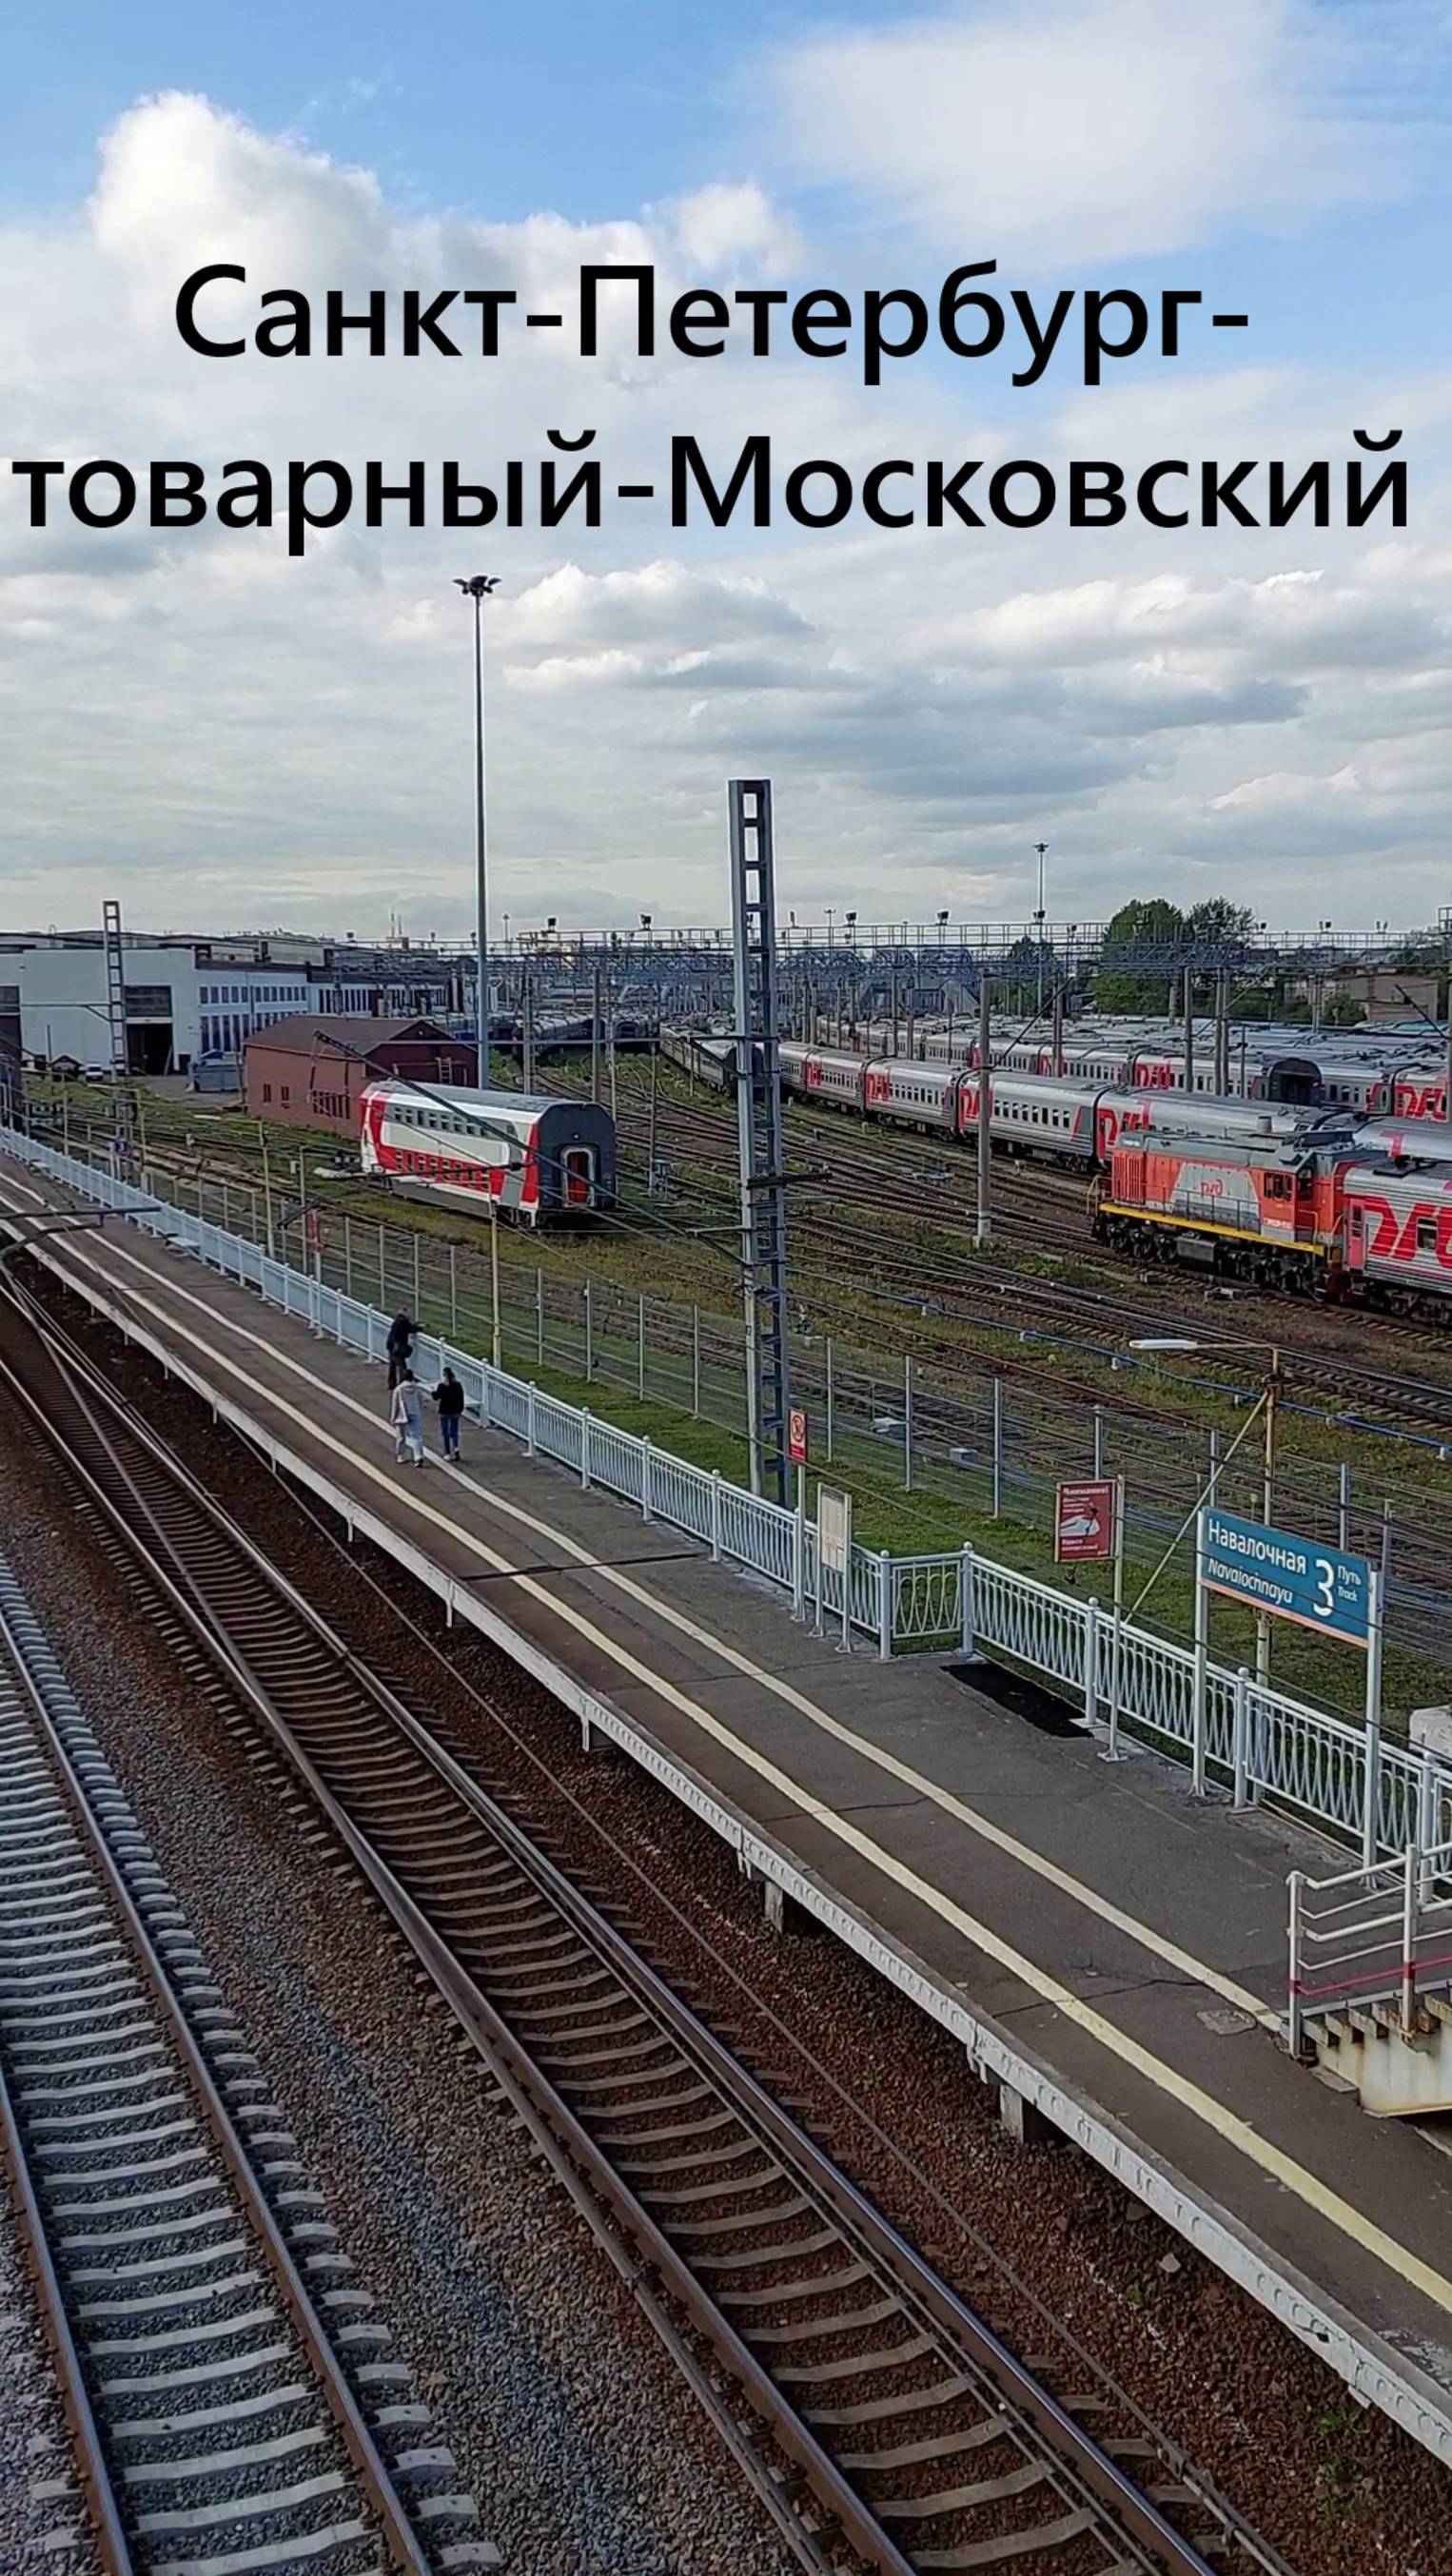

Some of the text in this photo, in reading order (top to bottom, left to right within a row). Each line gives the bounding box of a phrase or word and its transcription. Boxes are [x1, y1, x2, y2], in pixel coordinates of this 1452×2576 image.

[1207, 1518, 1306, 1575] Навалочная
[1207, 1557, 1293, 1605] Navalochnaya
[1313, 1559, 1335, 1616] 3
[1337, 1586, 1359, 1603] Track
[1338, 1565, 1363, 1586] Путь
